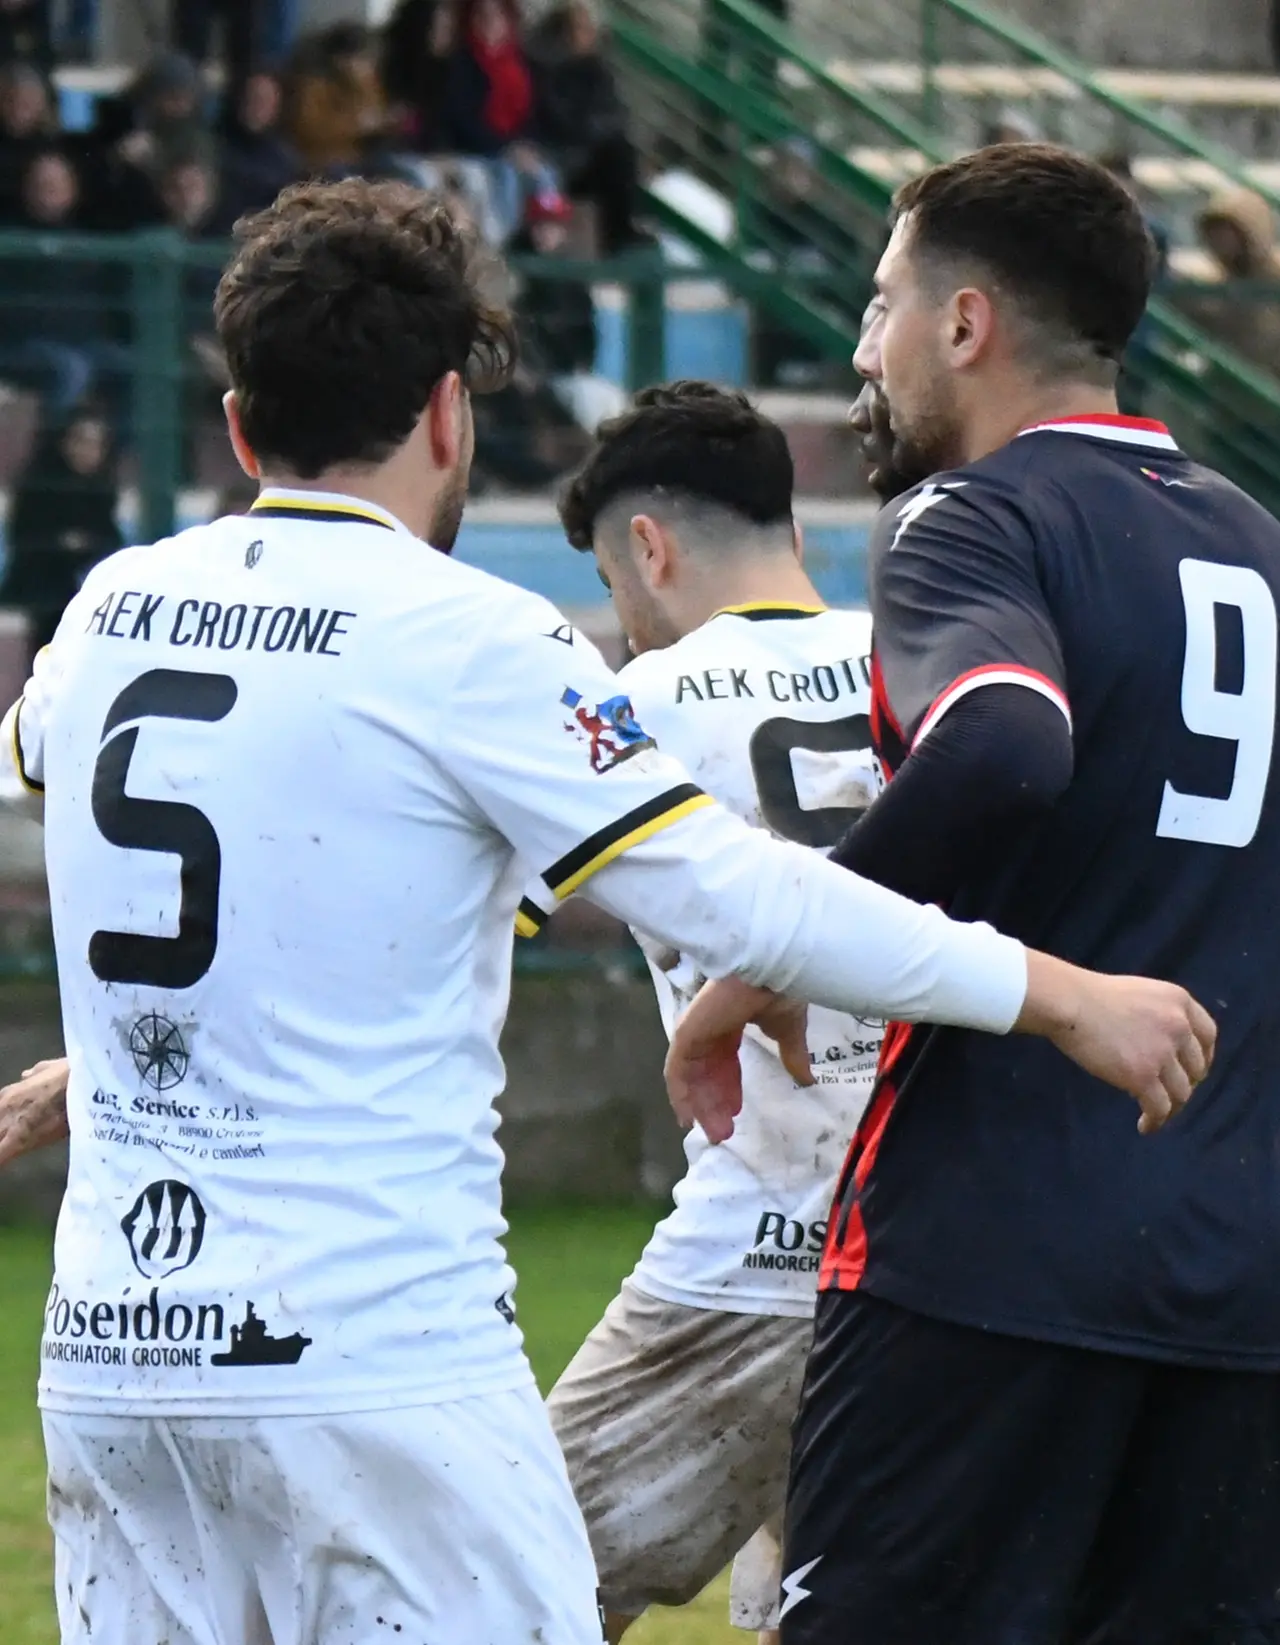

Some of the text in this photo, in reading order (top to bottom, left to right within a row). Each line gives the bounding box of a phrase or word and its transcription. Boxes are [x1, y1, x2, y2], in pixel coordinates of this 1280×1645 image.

[85, 591, 358, 656] AEK CROTONE
[675, 667, 755, 704] AEK
[1155, 557, 1278, 849] 9
[88, 668, 238, 989] 5
[132, 1347, 202, 1367] CROTONE
